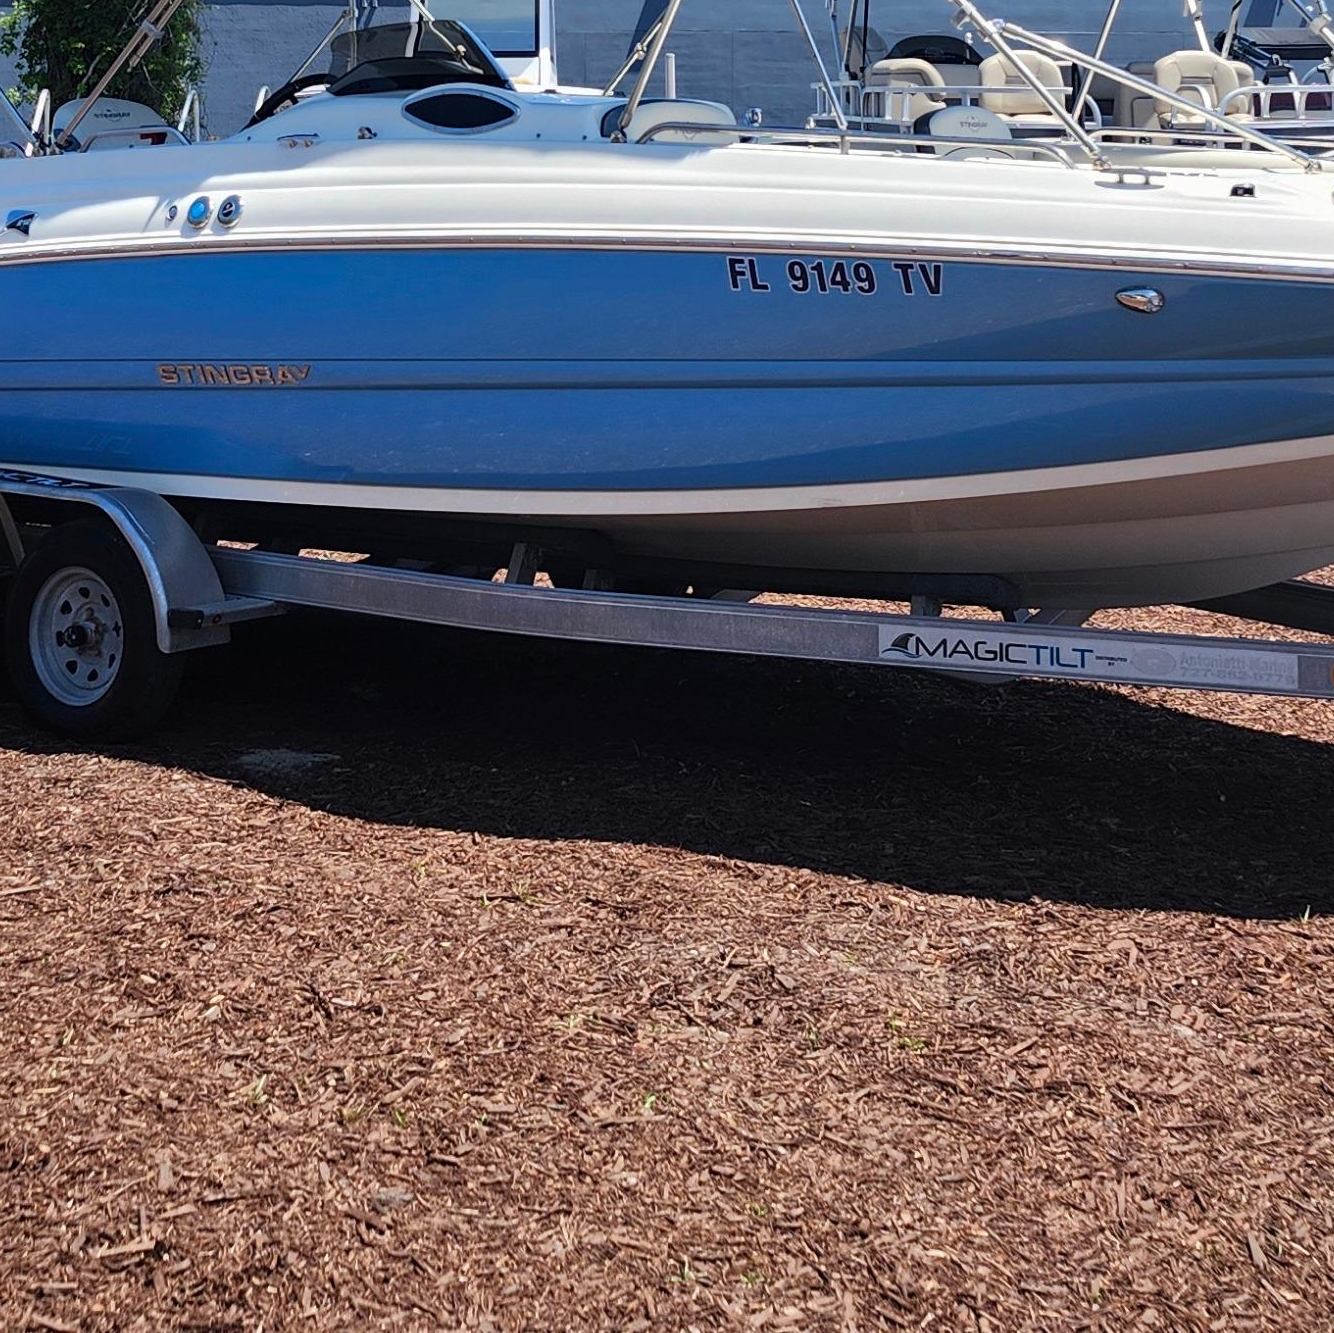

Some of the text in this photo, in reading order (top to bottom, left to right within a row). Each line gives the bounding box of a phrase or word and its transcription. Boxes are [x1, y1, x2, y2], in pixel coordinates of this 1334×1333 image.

[727, 257, 944, 296] FL 9149 TV
[157, 363, 312, 385] STINGRAY
[915, 634, 1094, 669] MAGICTILT
